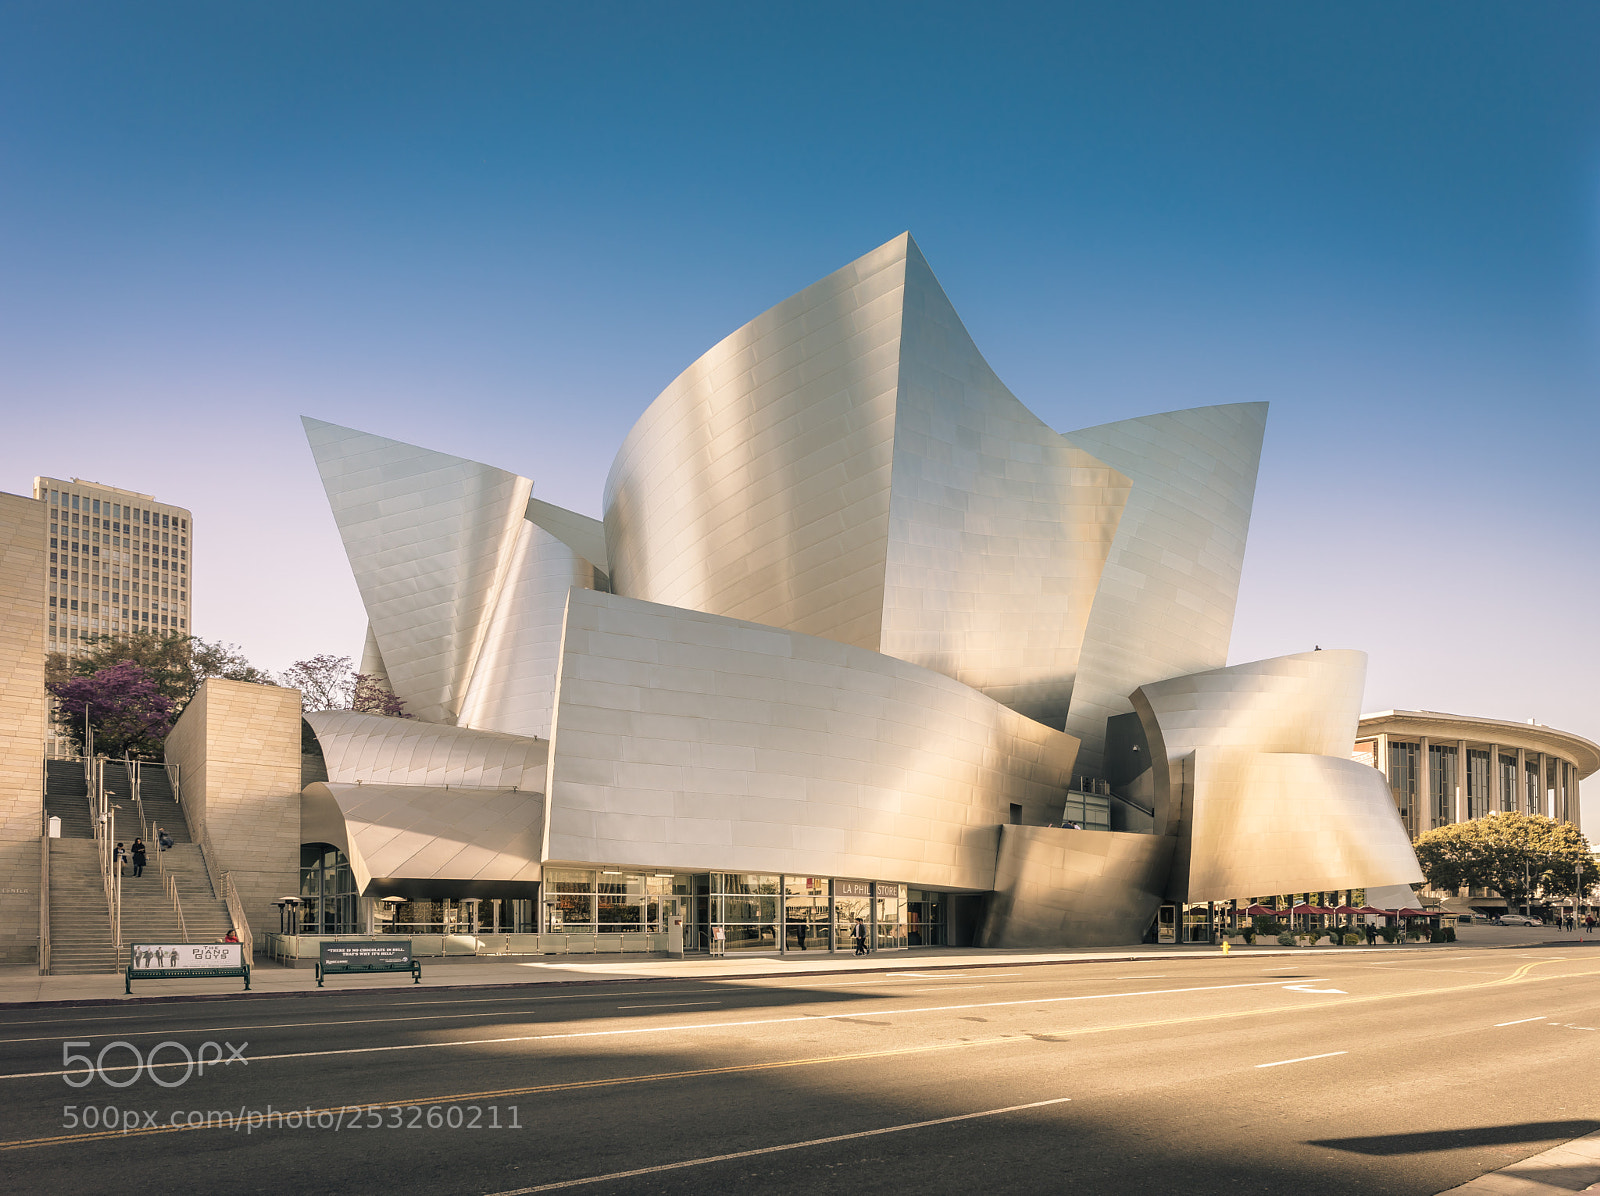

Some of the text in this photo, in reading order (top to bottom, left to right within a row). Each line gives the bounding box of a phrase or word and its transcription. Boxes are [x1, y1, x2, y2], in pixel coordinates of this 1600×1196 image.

[842, 884, 897, 896] LA PHIL STORE
